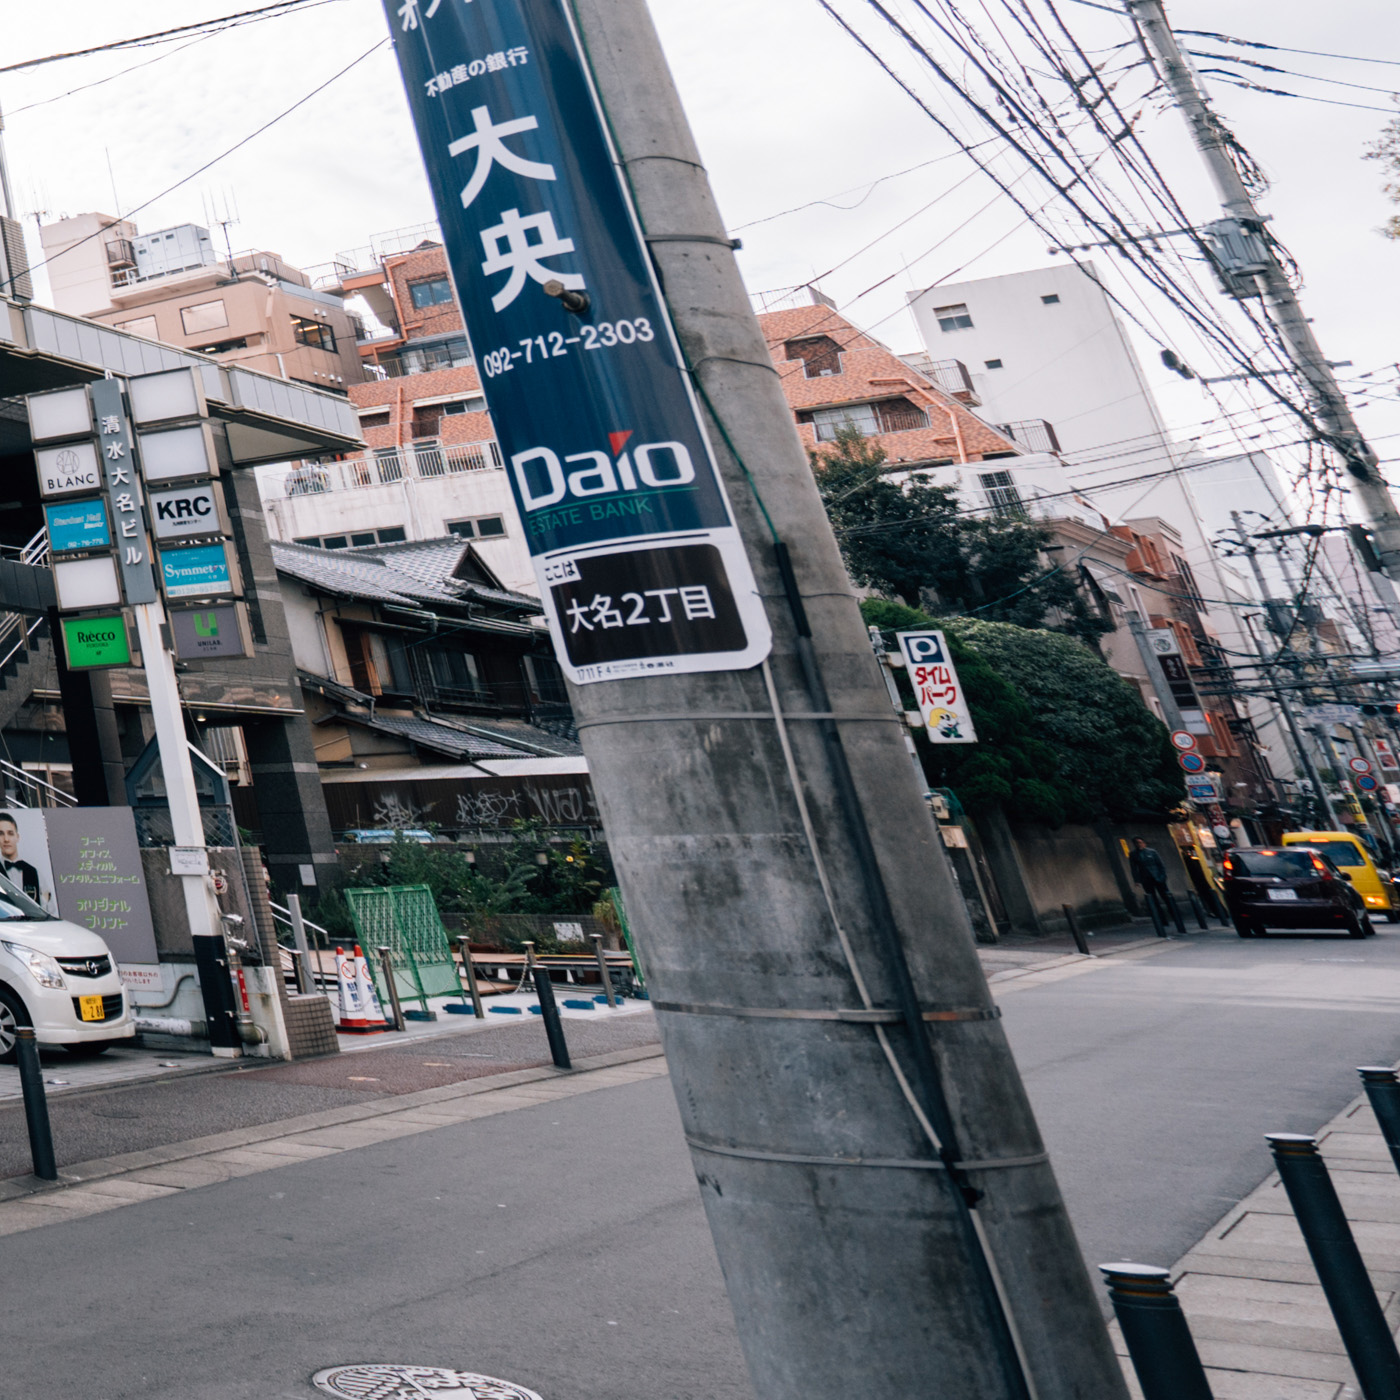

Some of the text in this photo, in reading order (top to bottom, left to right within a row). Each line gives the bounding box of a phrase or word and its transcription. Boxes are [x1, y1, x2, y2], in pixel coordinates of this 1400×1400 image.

[424, 46, 529, 98] 不動産の銀行
[448, 105, 586, 313] 大央
[483, 317, 654, 378] 092-712-2303
[47, 472, 95, 490] BLANC
[511, 432, 696, 512] Daio
[101, 415, 143, 566] 清水大名ビル
[157, 496, 212, 520] KRC
[529, 497, 652, 536] ESTATE BANK
[545, 560, 576, 582] ここは
[566, 585, 716, 634] 大名2丁目
[908, 638, 938, 662] P
[915, 666, 952, 685] タイム
[921, 686, 956, 705] パーク
[81, 837, 105, 846] フード
[80, 849, 112, 858] オフィス
[79, 860, 117, 871] メディカル
[60, 874, 140, 884] レンタルユニフォーム
[76, 898, 131, 913] オリジナル
[85, 914, 128, 930] プリント
